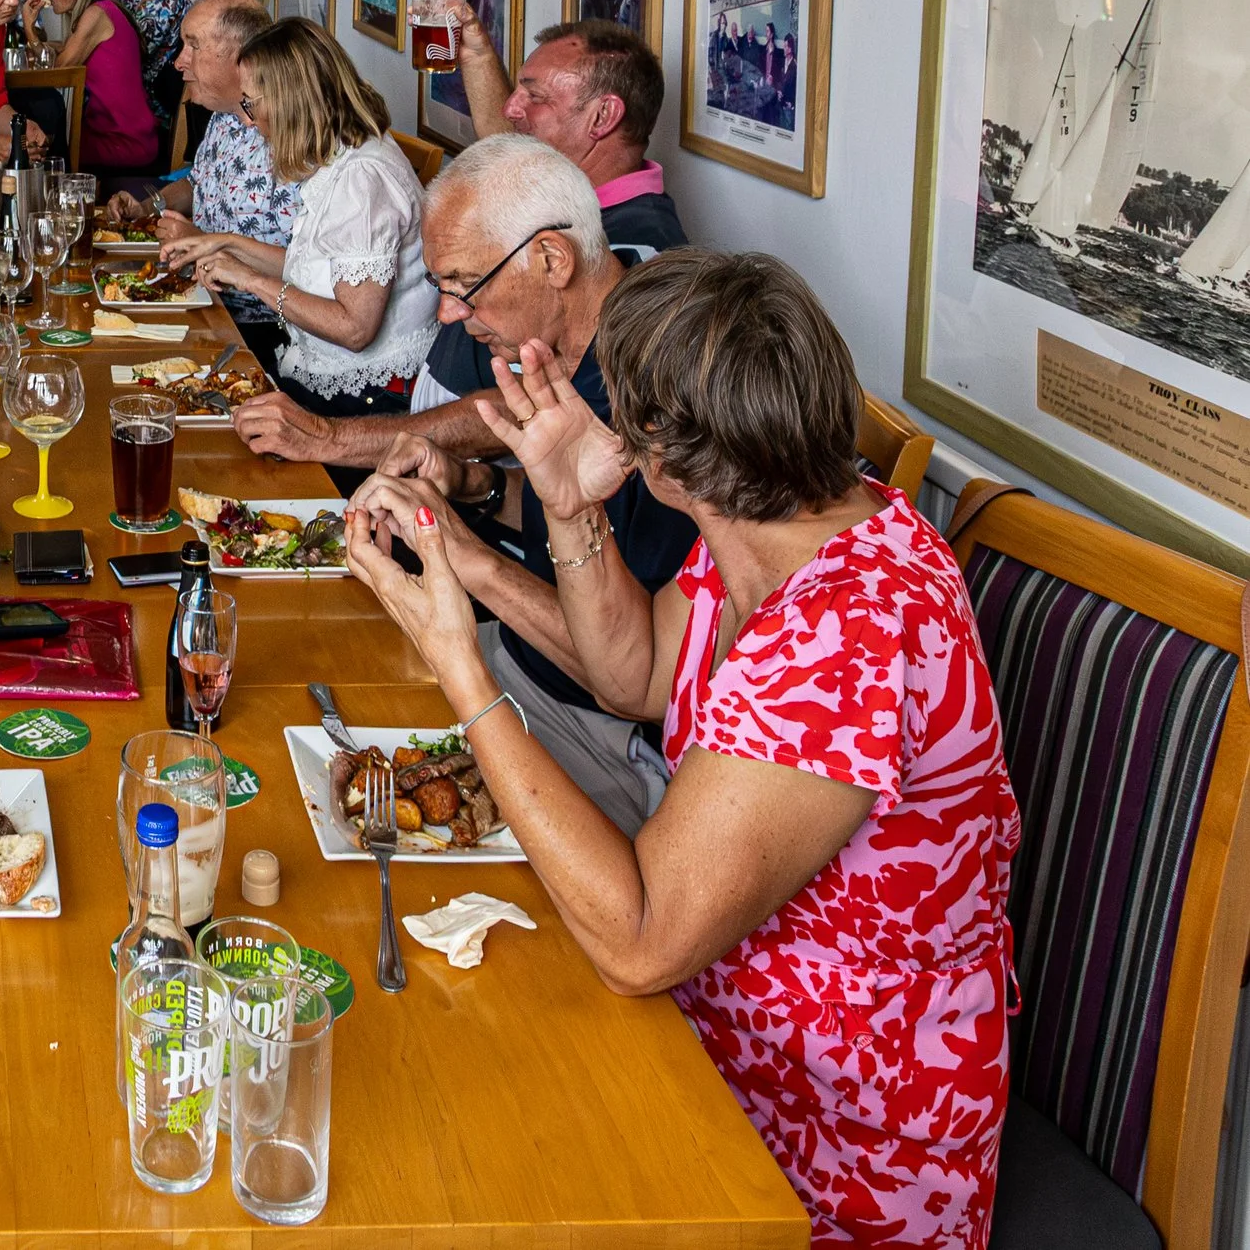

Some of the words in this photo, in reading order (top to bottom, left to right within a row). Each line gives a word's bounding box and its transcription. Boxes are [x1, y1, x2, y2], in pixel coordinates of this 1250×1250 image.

[1149, 381, 1181, 403] TROY
[1186, 399, 1221, 422] CLASS
[7, 723, 55, 751] IPA
